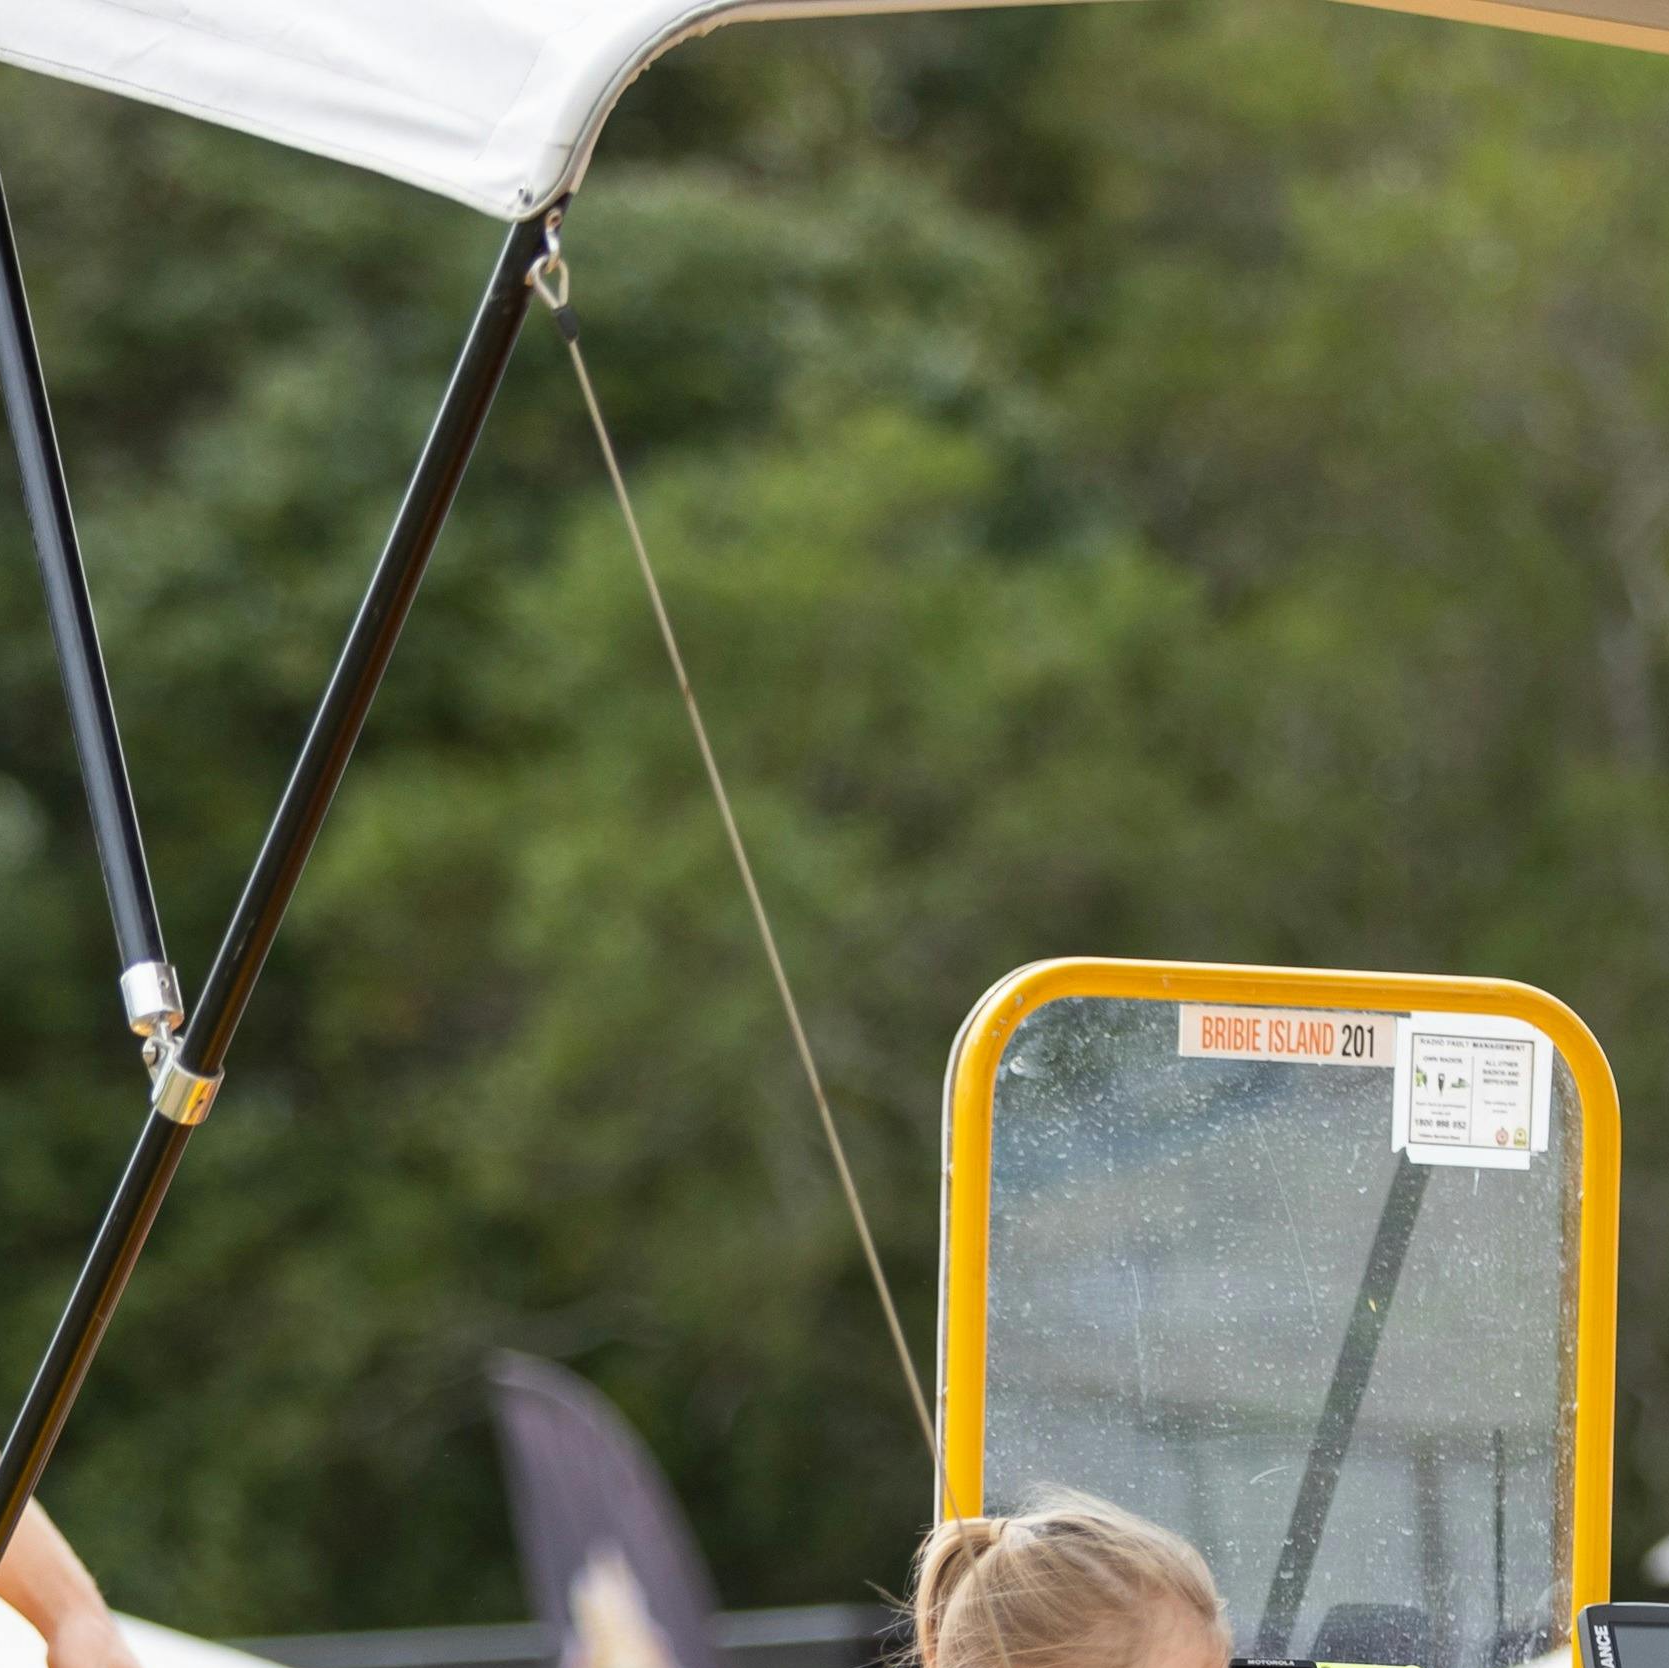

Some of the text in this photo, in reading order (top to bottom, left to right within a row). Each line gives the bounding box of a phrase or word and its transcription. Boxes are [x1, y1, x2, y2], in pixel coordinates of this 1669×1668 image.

[1201, 1015, 1375, 1058] BRIBIE ISLAND 201
[1247, 1659, 1295, 1667] MOTOROLA
